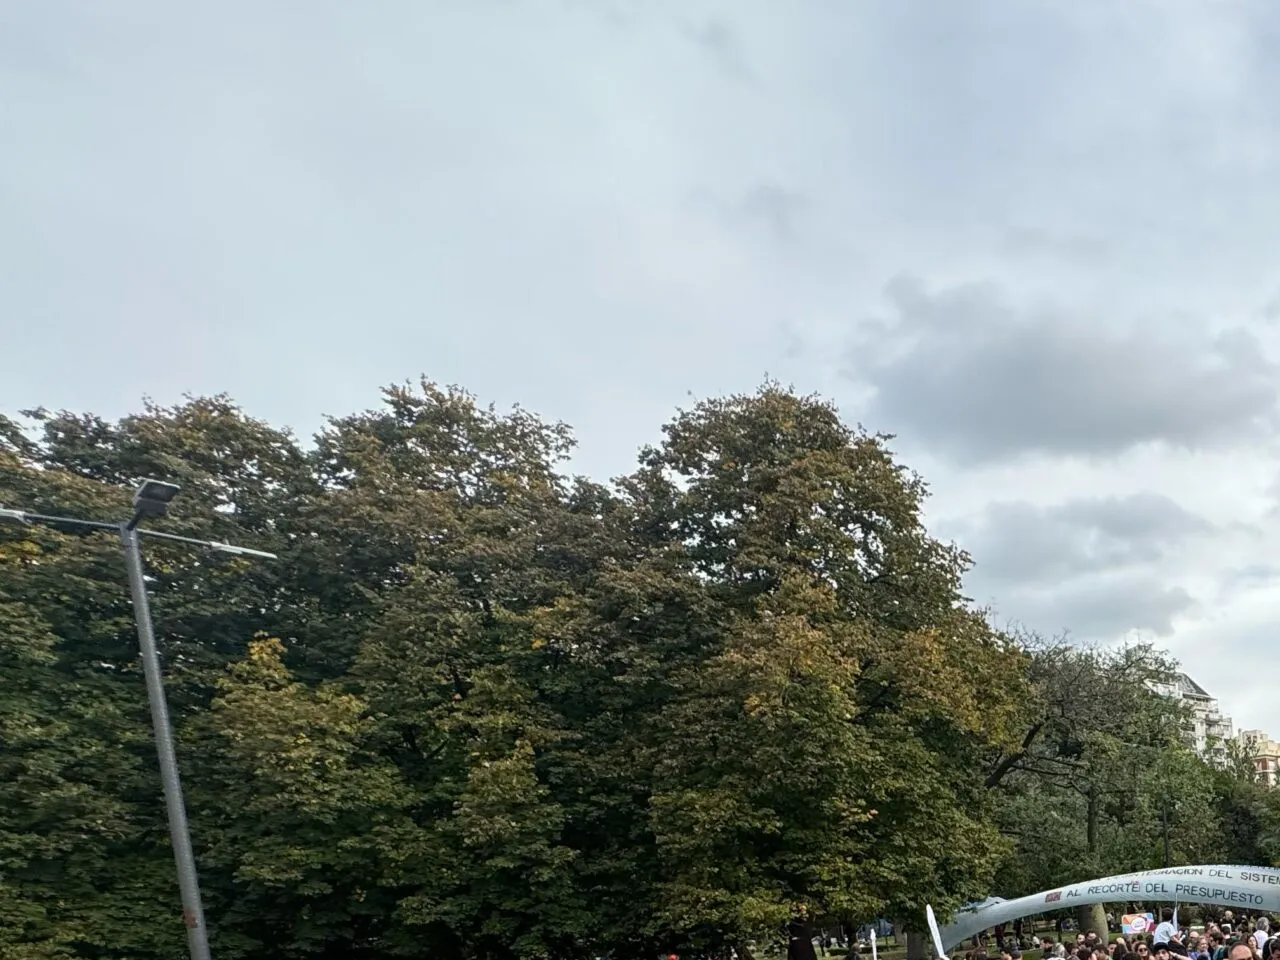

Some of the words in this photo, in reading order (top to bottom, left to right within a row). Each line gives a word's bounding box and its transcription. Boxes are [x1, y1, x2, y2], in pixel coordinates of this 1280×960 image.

[1209, 868, 1233, 879] DEL
[1066, 889, 1082, 898] AL
[1087, 884, 1139, 895] RECORTE
[1145, 883, 1169, 893] DEL
[1175, 883, 1264, 905] PRESUPUESTO
